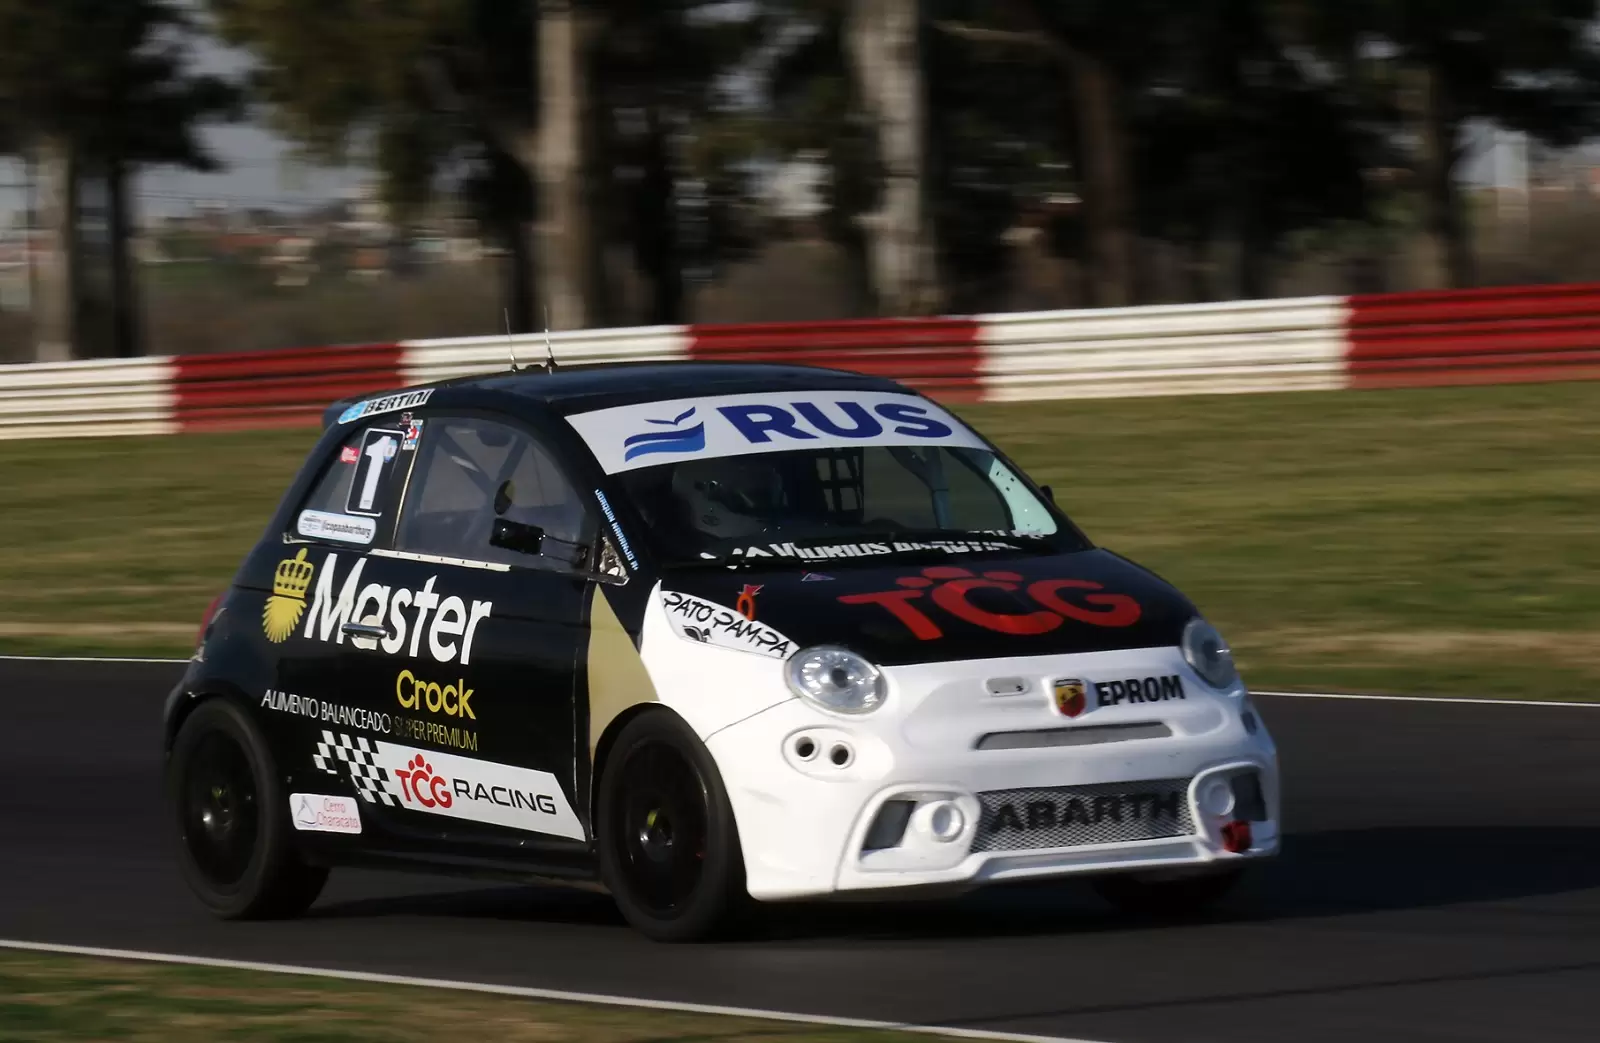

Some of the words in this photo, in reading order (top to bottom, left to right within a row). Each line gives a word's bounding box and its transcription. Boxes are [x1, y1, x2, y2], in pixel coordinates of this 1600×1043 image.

[364, 390, 431, 414] BERTINI
[716, 401, 952, 444] RUS
[359, 435, 392, 510] 1
[303, 553, 493, 665] Master
[664, 592, 716, 622] PATO
[713, 612, 790, 658] PAMPA
[837, 578, 1142, 641] TCG
[396, 669, 477, 720] Crock
[1093, 675, 1186, 707] EPROM
[260, 689, 320, 719] ALIMENTO
[320, 701, 392, 734] BALANCEADO
[427, 724, 478, 752] PREMIUM
[395, 768, 453, 809] TCG
[453, 778, 557, 815] RACING
[991, 790, 1181, 832] ABARTH
